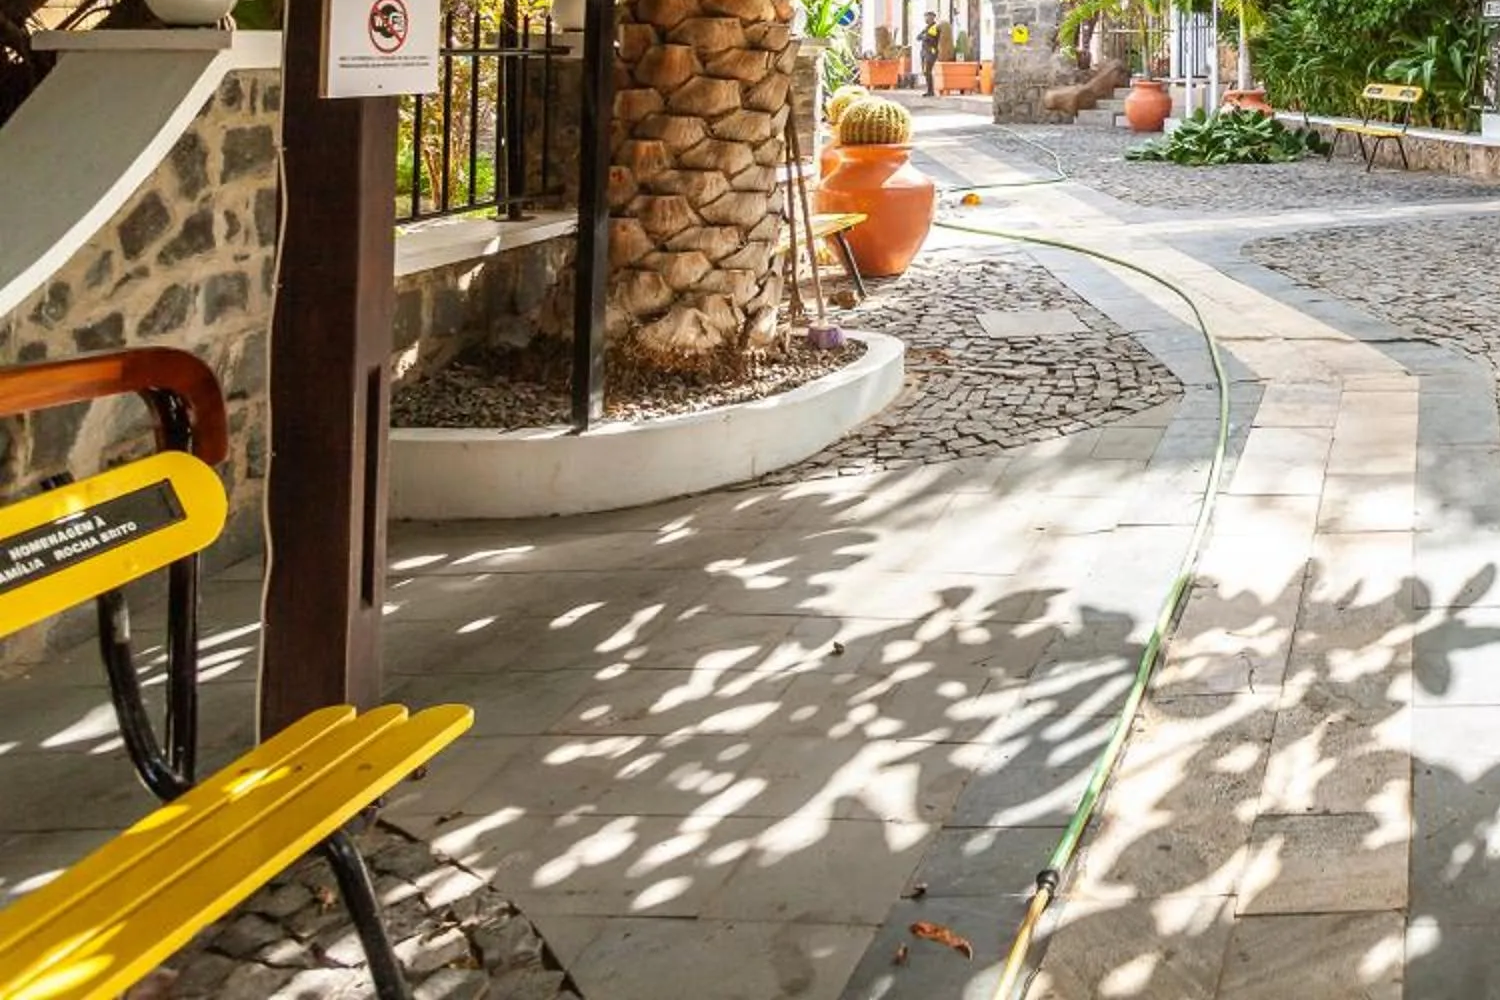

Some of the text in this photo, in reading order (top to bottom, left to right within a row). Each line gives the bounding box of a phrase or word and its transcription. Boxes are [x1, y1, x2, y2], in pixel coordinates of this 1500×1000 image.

[0, 521, 137, 584] AMÍLIA ROCHA BRITO
[8, 520, 95, 559] HOMENAGEM
